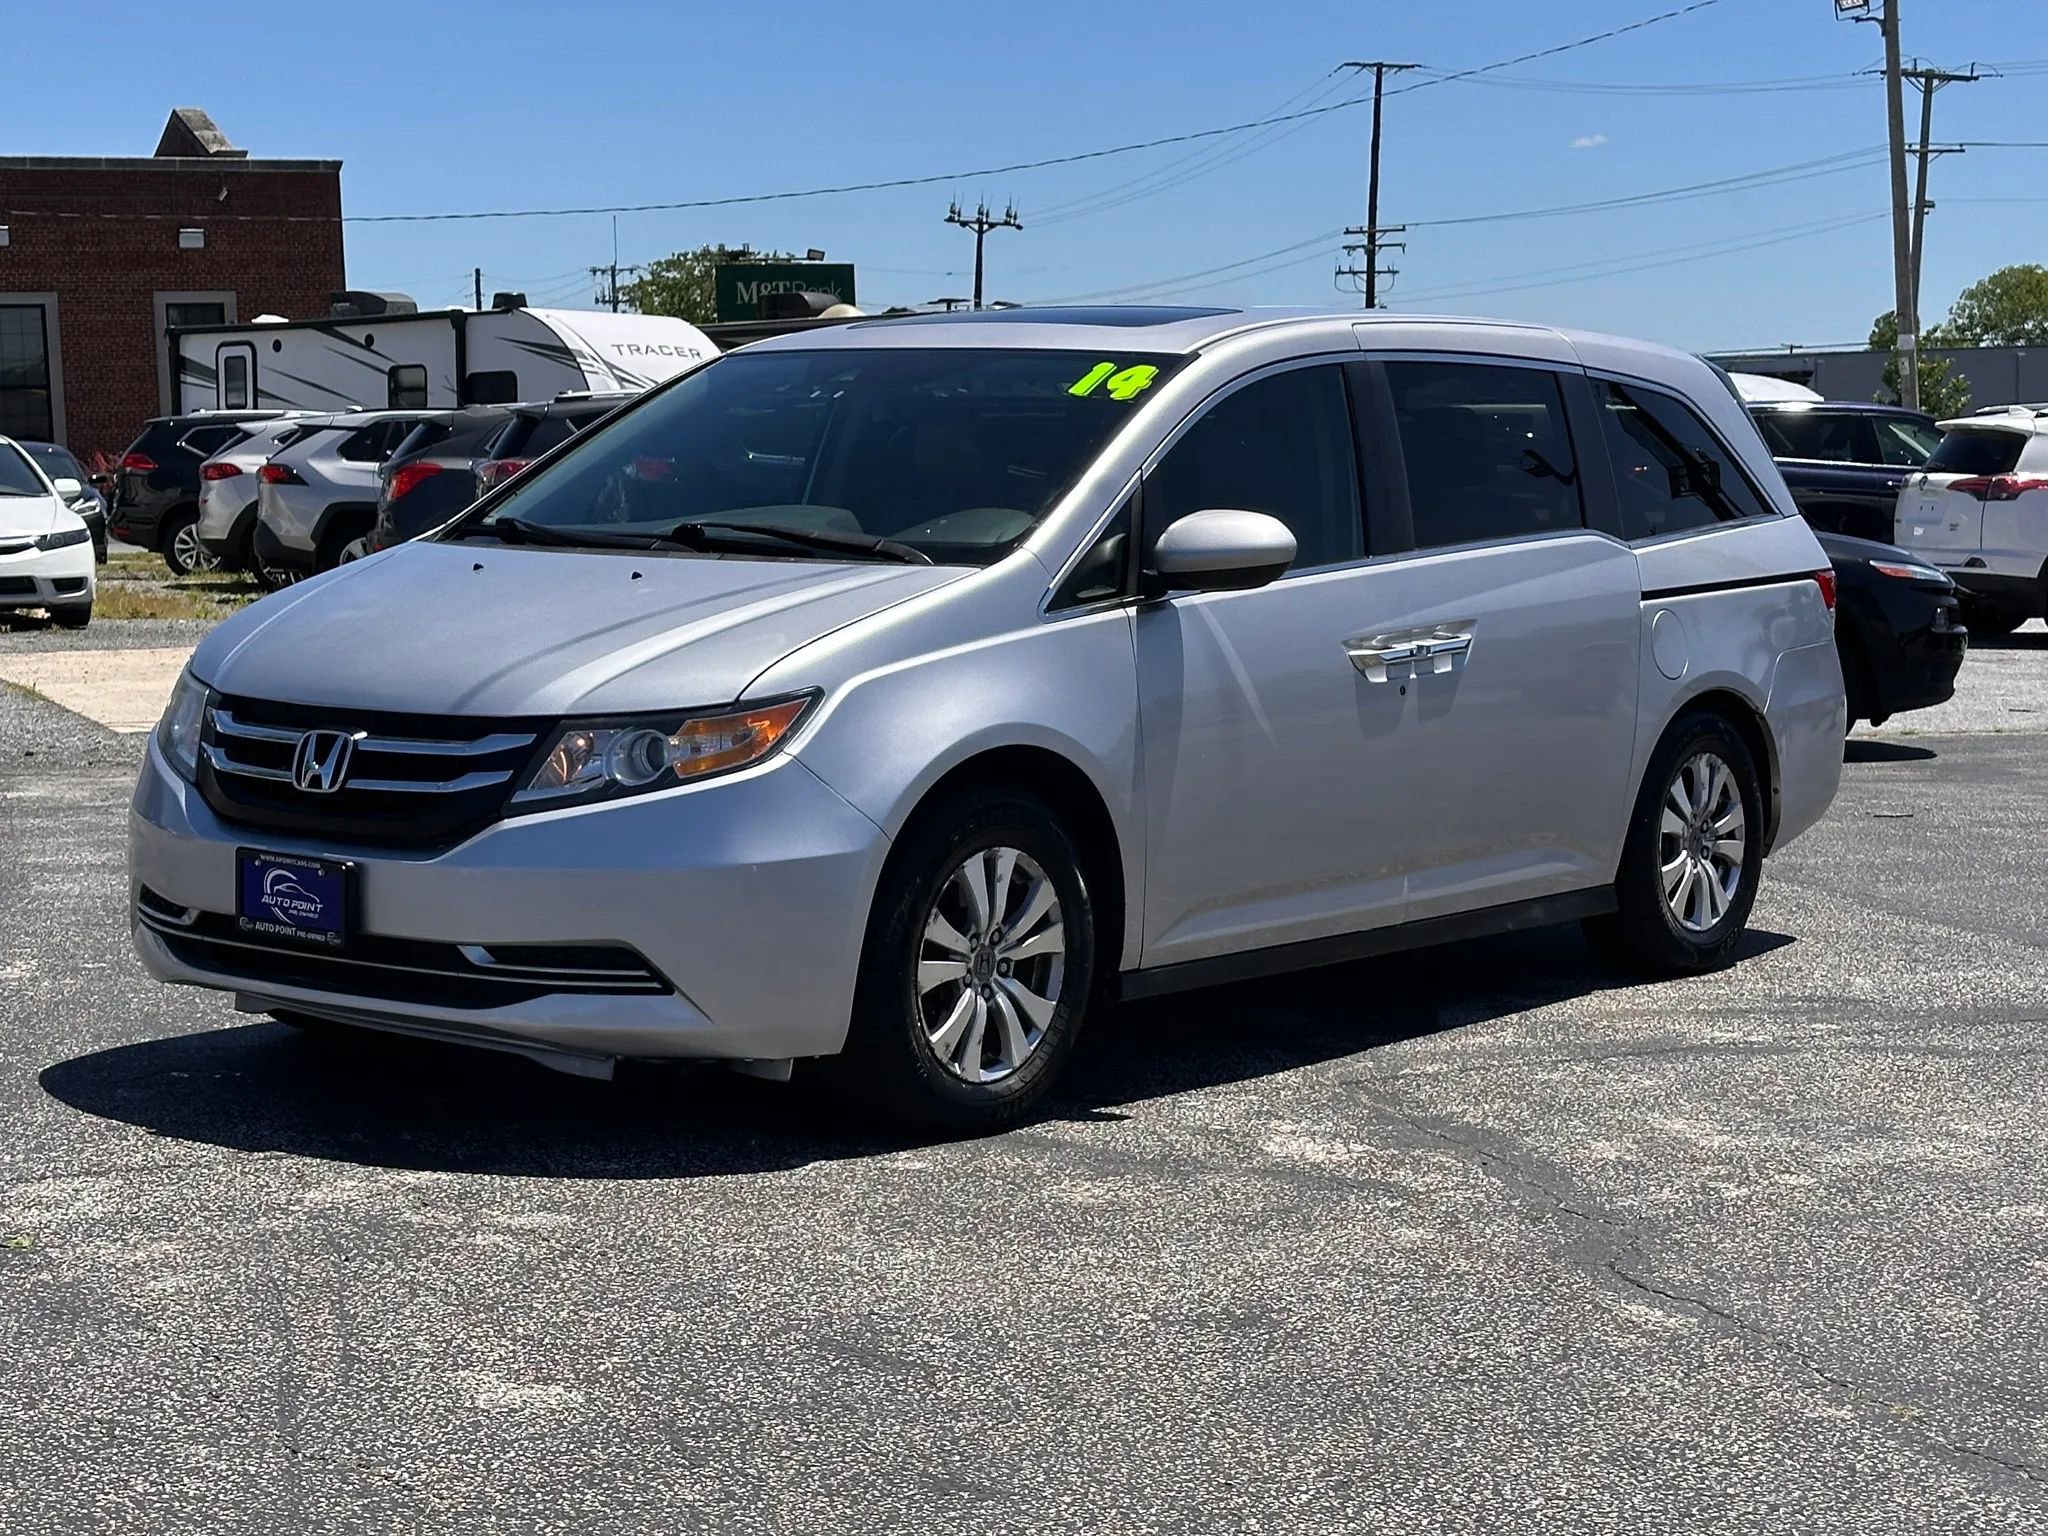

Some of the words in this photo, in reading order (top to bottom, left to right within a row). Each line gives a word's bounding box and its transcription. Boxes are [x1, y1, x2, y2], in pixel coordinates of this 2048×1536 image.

[610, 344, 702, 360] TRACER
[1068, 362, 1159, 401] 14
[261, 895, 290, 907] AUTO
[291, 900, 324, 913] POINT
[255, 921, 275, 933] AUTO
[275, 925, 297, 937] POINT
